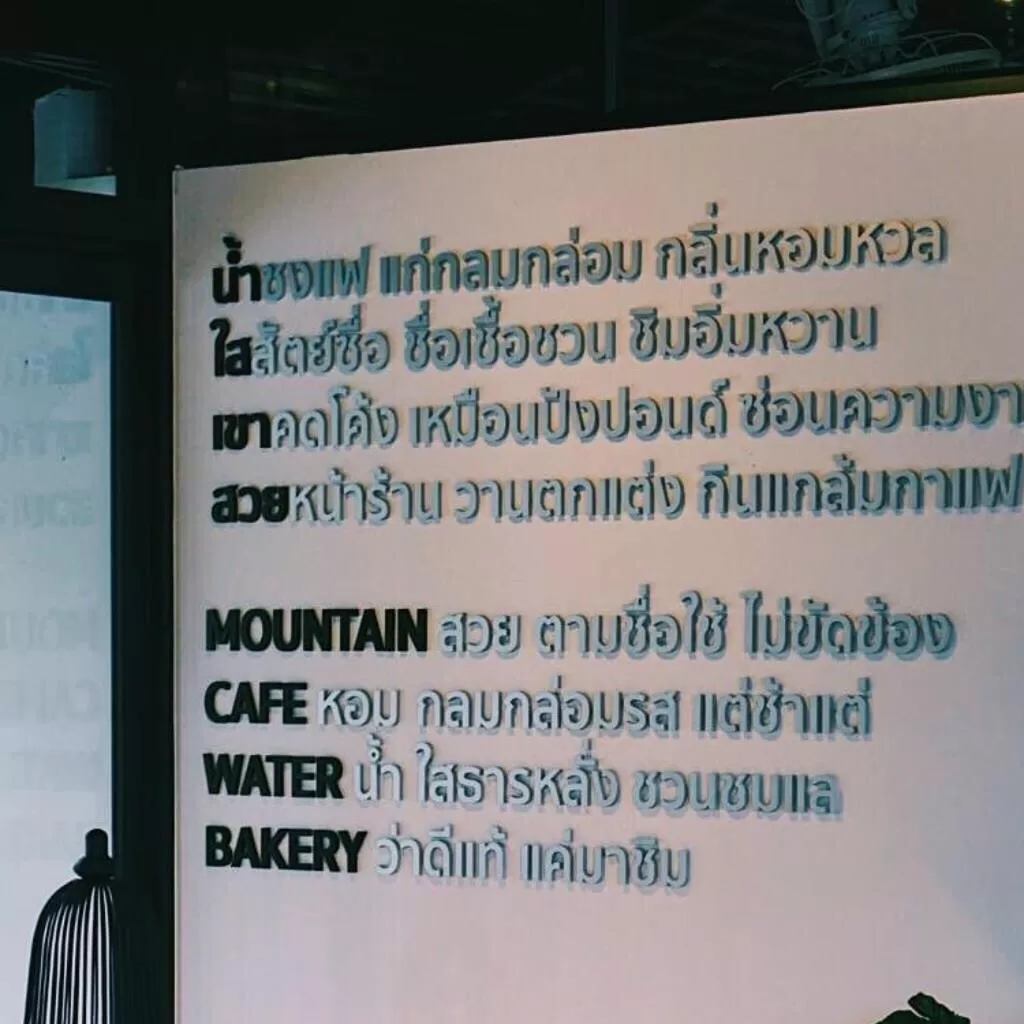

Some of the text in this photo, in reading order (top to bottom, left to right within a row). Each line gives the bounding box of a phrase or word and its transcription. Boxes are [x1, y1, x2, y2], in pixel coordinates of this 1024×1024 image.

[205, 608, 428, 652] MOUNTAIN
[441, 611, 522, 658] สวย
[203, 681, 308, 724] CAFE
[317, 687, 400, 730] หอม
[203, 752, 344, 799] WATER
[355, 732, 404, 806] น้ำ
[205, 825, 368, 873] BAKERY
